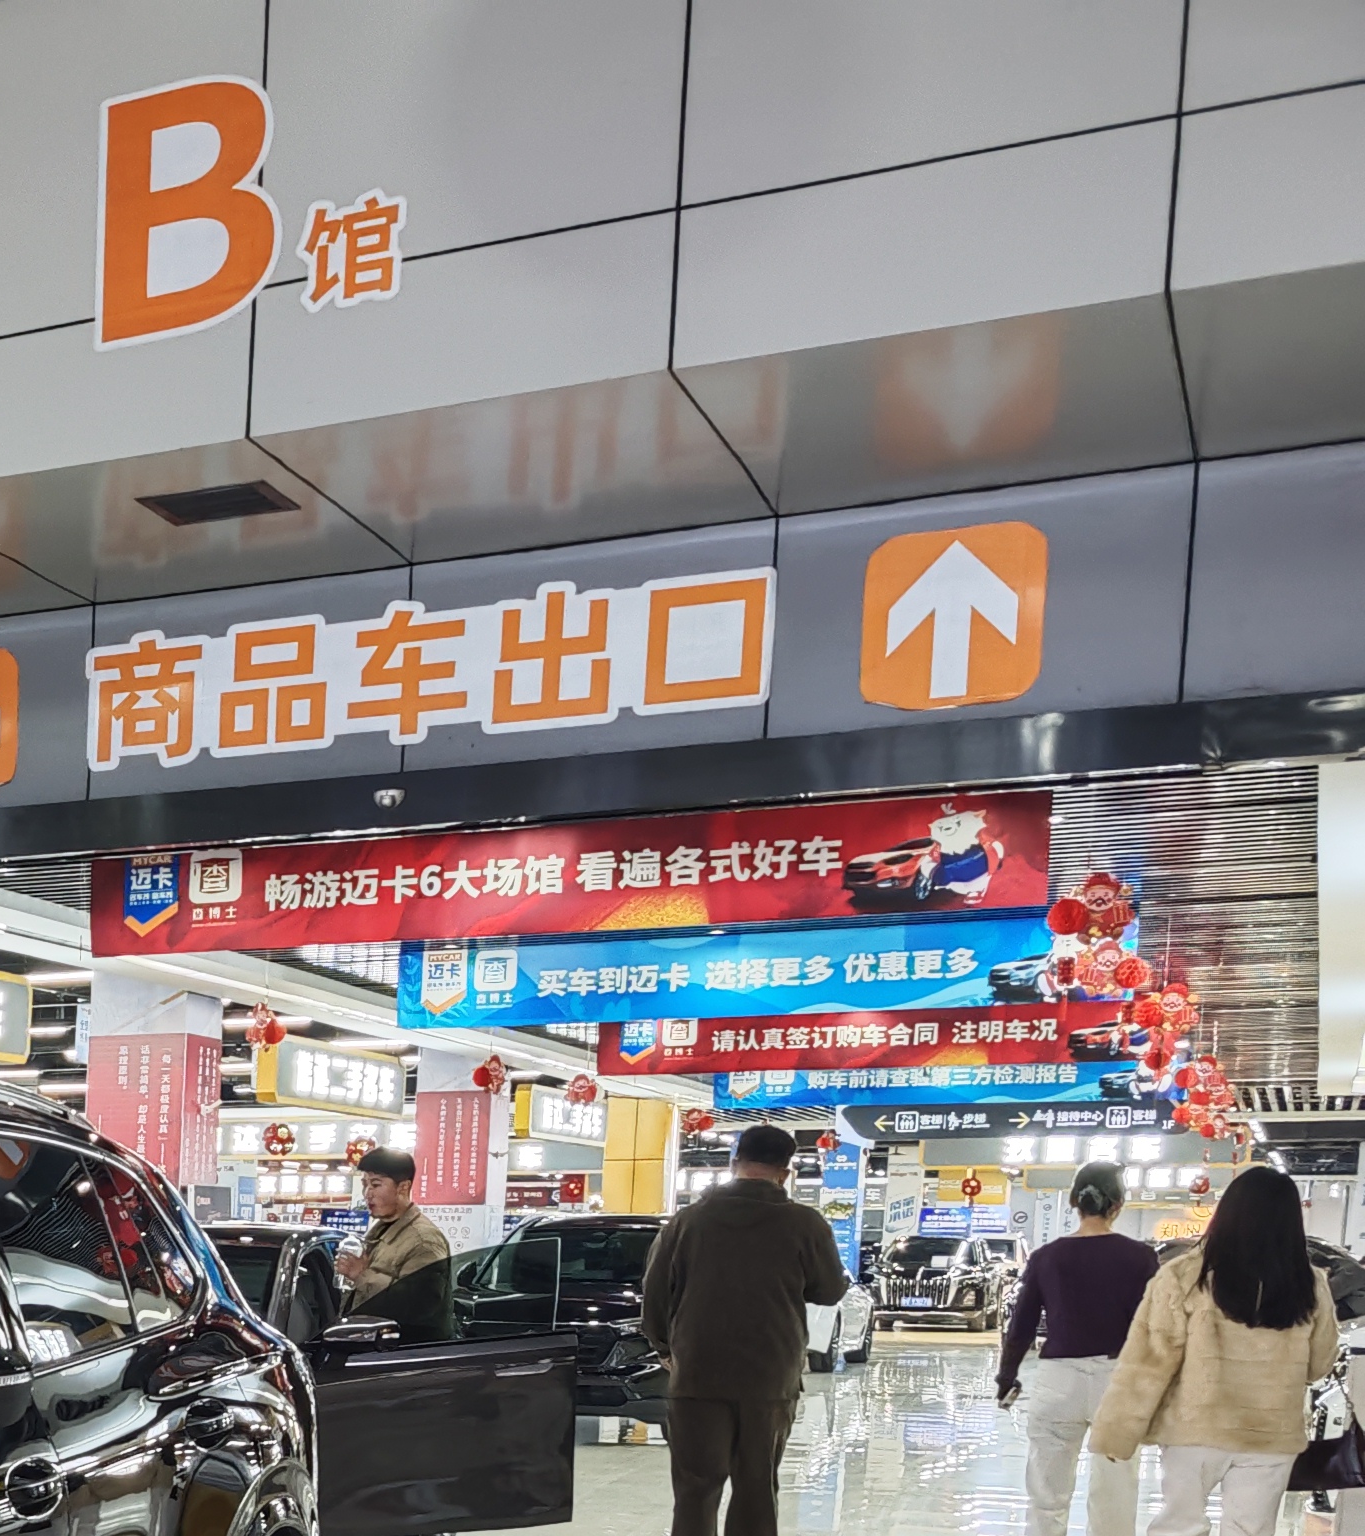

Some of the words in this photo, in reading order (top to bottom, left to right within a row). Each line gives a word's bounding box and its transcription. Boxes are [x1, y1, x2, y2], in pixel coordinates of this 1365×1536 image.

[95, 74, 407, 352] B馆
[87, 566, 776, 772] 商品车出口
[130, 868, 173, 891] 迈卡
[264, 854, 565, 912] 畅游迈卡6大场馆
[575, 836, 843, 892] 看遍各式好车
[428, 963, 462, 980] 迈卡
[536, 962, 691, 998] 买车到迈卡
[704, 954, 834, 991] 选择更多
[843, 947, 979, 984] 优惠更多
[711, 1021, 939, 1053] 请认真签订购车合同
[951, 1018, 1059, 1044] 注明车况
